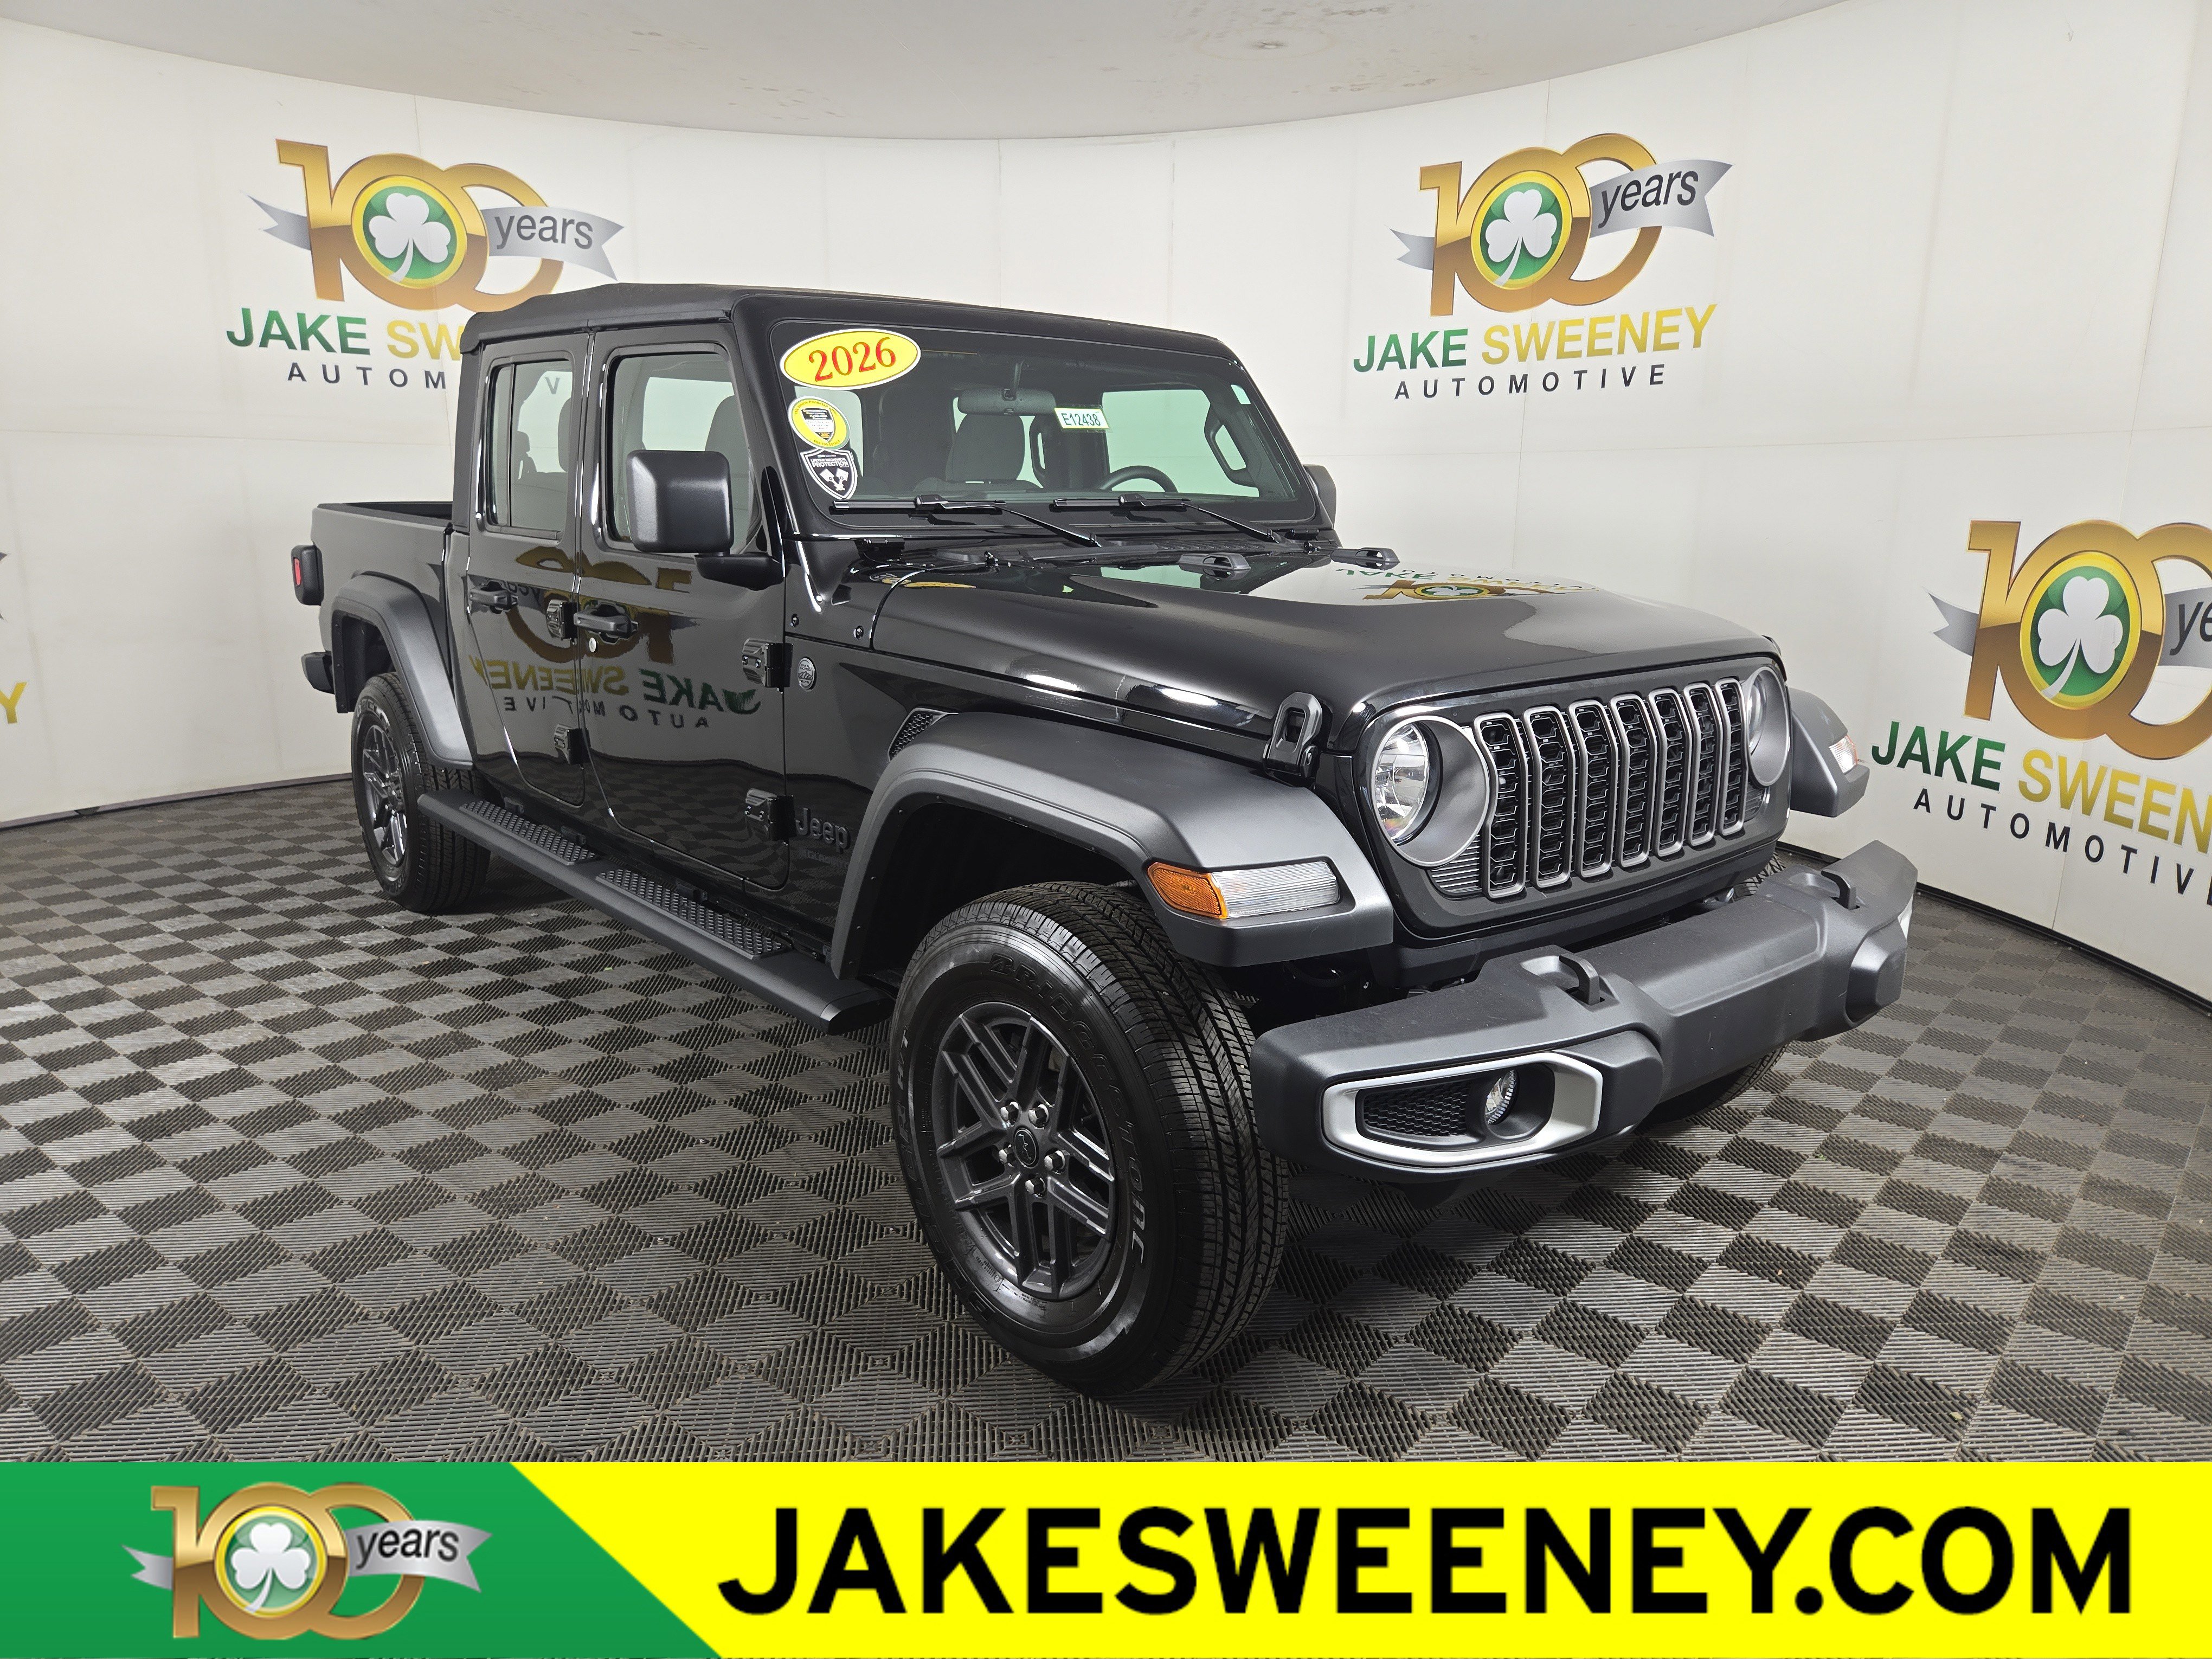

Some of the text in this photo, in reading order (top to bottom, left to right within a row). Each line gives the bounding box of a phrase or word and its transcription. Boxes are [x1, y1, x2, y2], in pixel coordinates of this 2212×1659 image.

[1598, 170, 1699, 229] years
[494, 214, 594, 250] years
[1419, 132, 1663, 317] 100
[226, 307, 461, 362] JAKE SW
[1353, 303, 1718, 373] JAKE SWEENEY
[287, 362, 446, 390] AUTOM
[808, 336, 897, 382] 2026
[1394, 364, 1665, 400] AUTOMOTIVE
[1061, 413, 1101, 426] E12438
[1872, 721, 2212, 854] JAKE SWEEN
[795, 807, 847, 853] Jeep
[807, 849, 848, 869] GLADIATO
[989, 953, 1146, 1264] BRIDGESTONE
